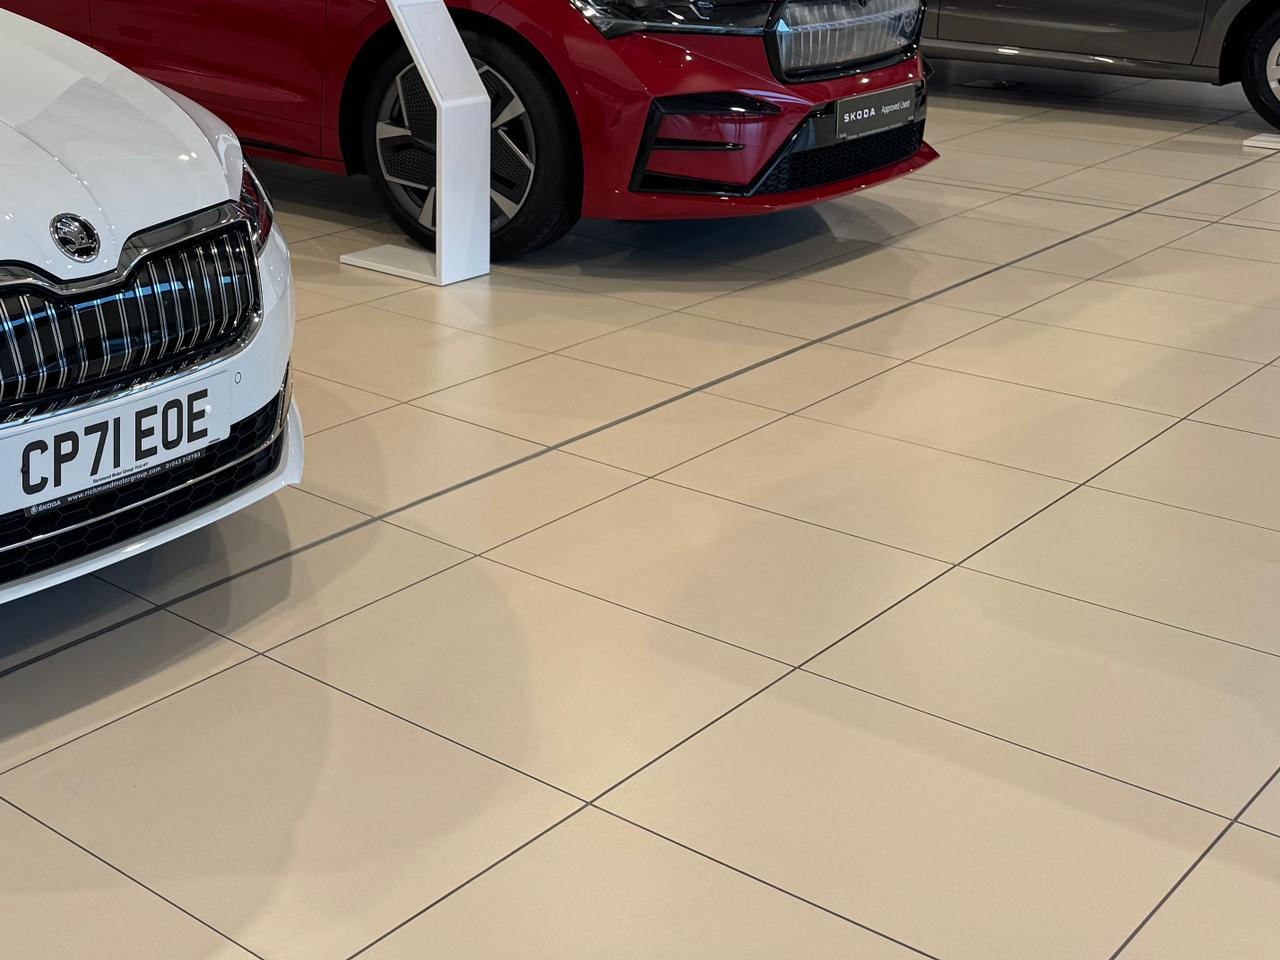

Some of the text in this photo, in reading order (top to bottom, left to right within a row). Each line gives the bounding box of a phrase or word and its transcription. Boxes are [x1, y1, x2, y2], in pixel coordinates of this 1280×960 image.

[843, 107, 876, 123] SKODA
[21, 388, 208, 496] CP71 EOE
[66, 466, 162, 502] www.richmondmotorgroup.com
